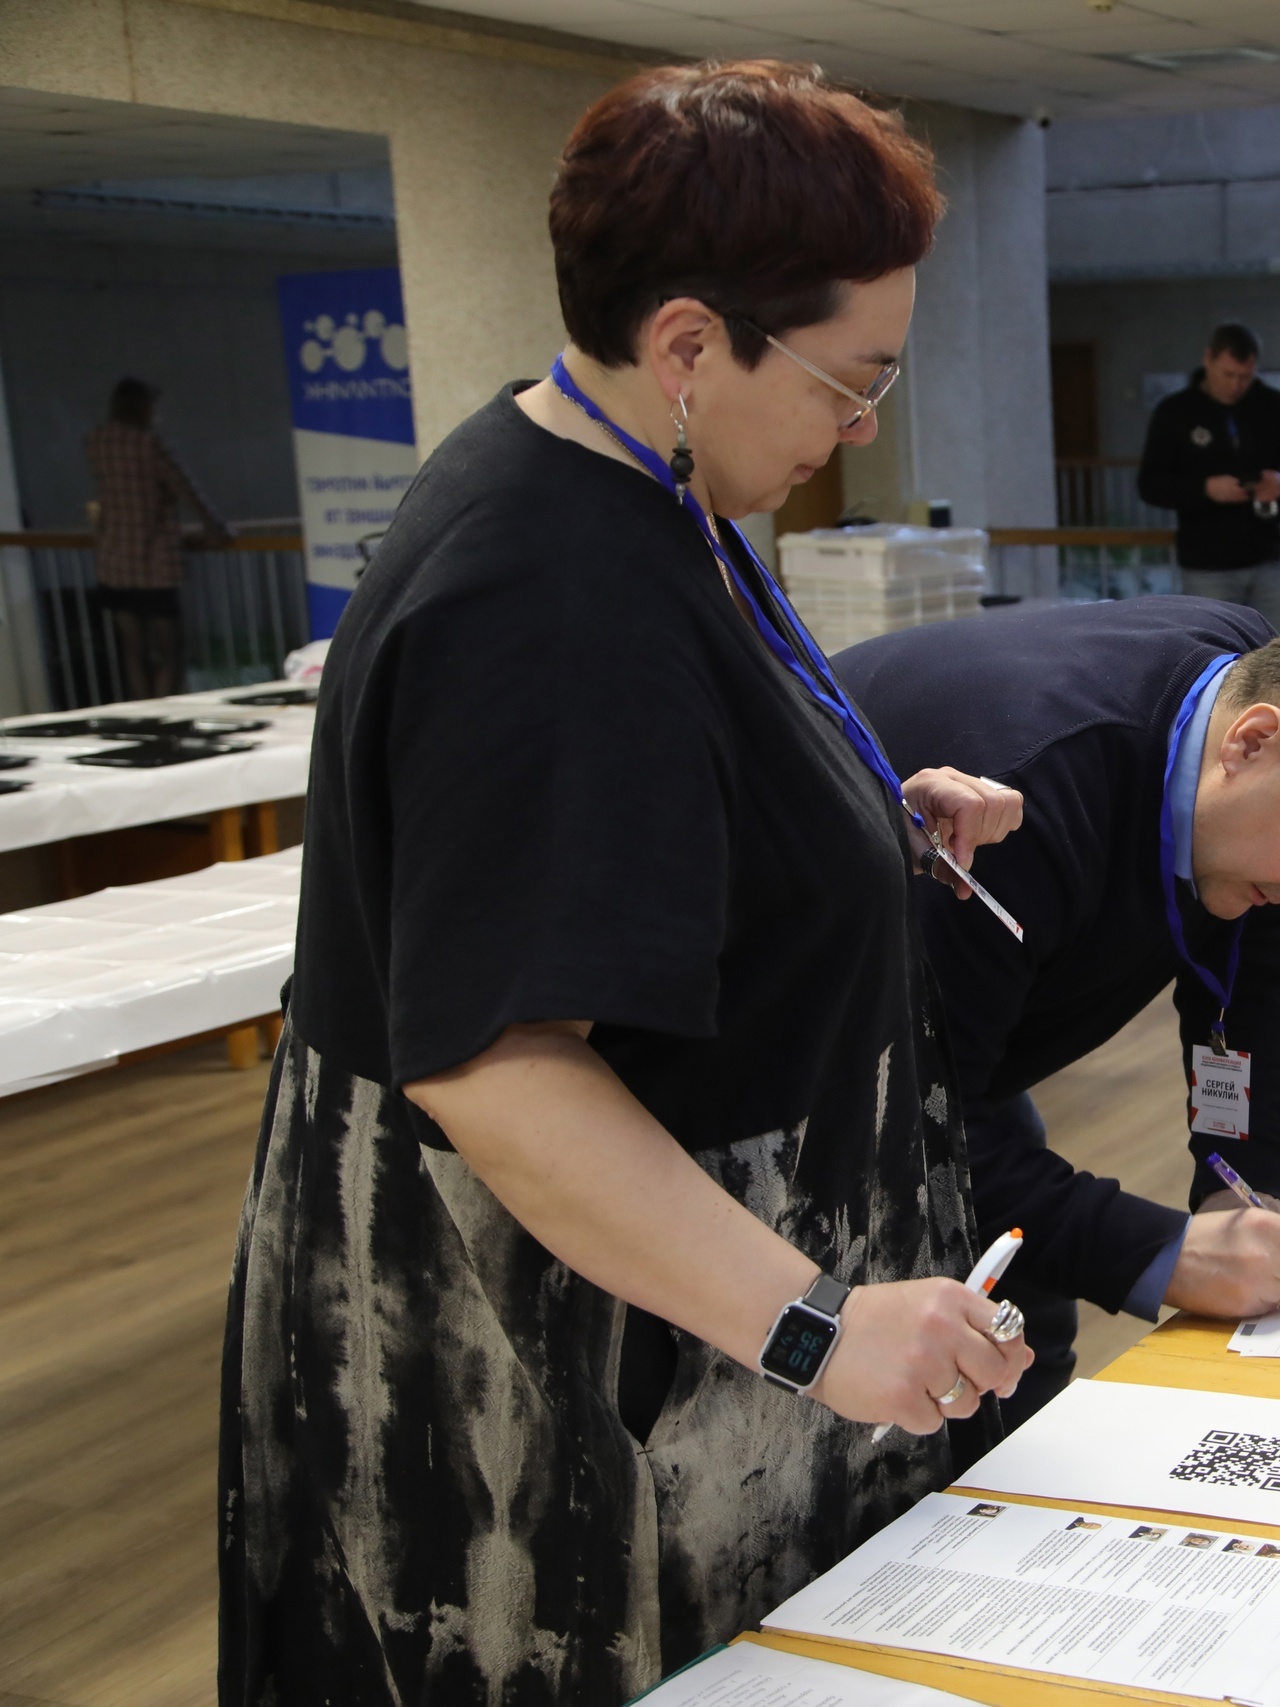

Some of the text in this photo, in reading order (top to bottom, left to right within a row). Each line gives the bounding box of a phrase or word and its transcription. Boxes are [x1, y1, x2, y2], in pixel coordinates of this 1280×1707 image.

[1202, 1087, 1239, 1101] НИКУЛИН
[1206, 1079, 1235, 1091] СЕРГЕЙ
[800, 1331, 823, 1353] 35
[788, 1350, 812, 1372] 10
